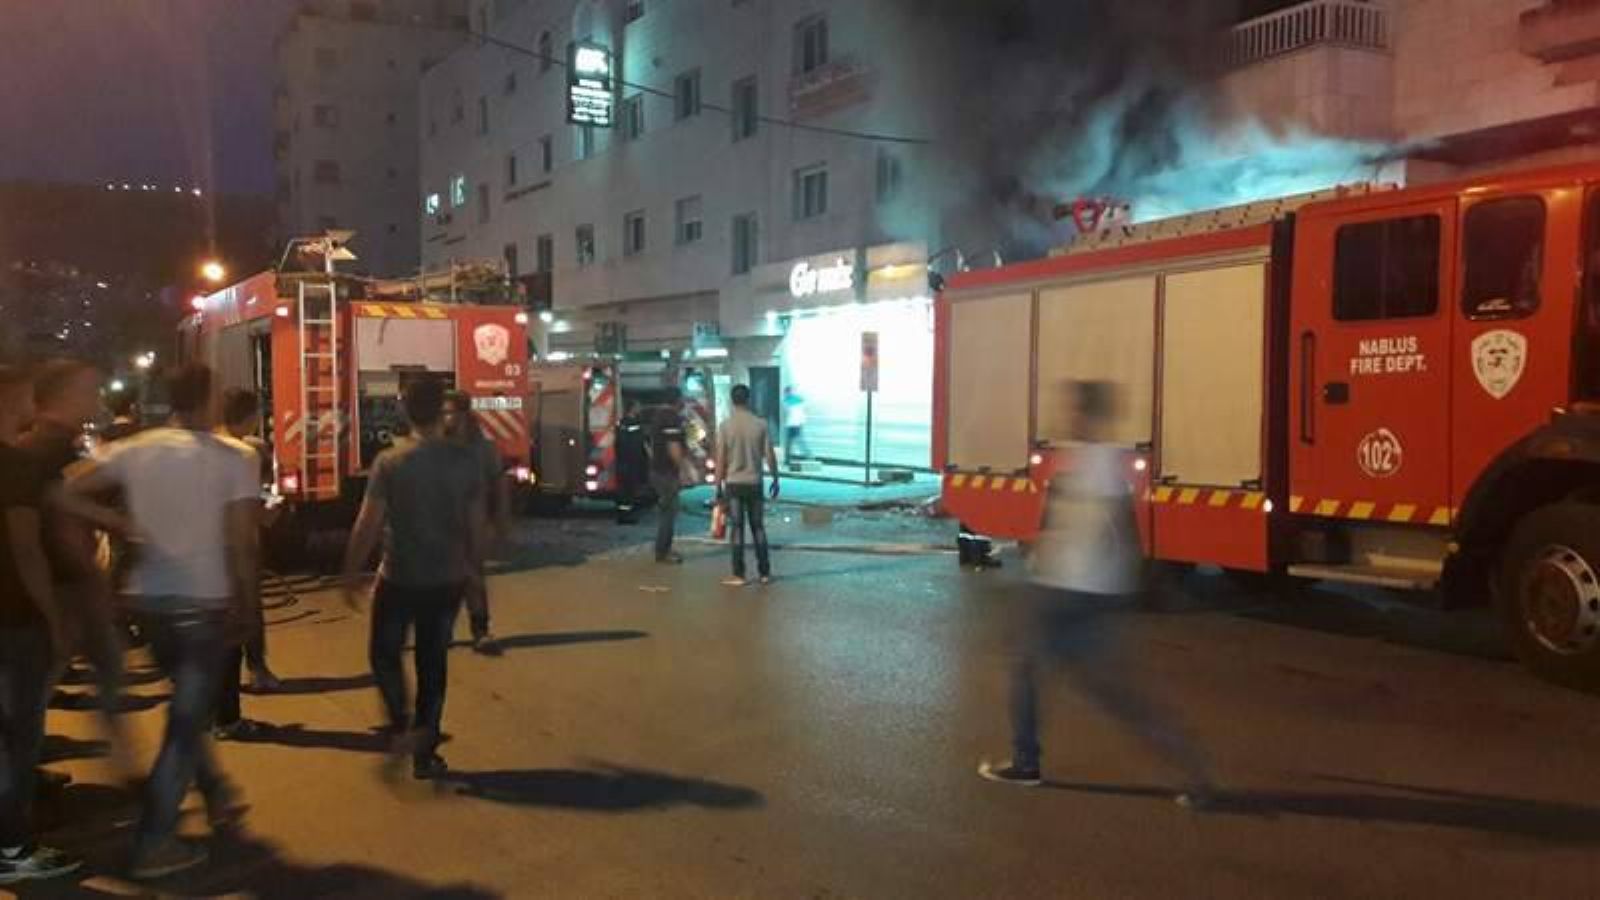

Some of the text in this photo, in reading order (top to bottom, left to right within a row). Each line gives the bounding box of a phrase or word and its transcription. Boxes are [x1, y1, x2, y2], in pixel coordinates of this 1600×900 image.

[1359, 336, 1418, 355] NABLUS
[1350, 354, 1427, 376] FIRE DEPT.
[1363, 440, 1393, 471] 102
